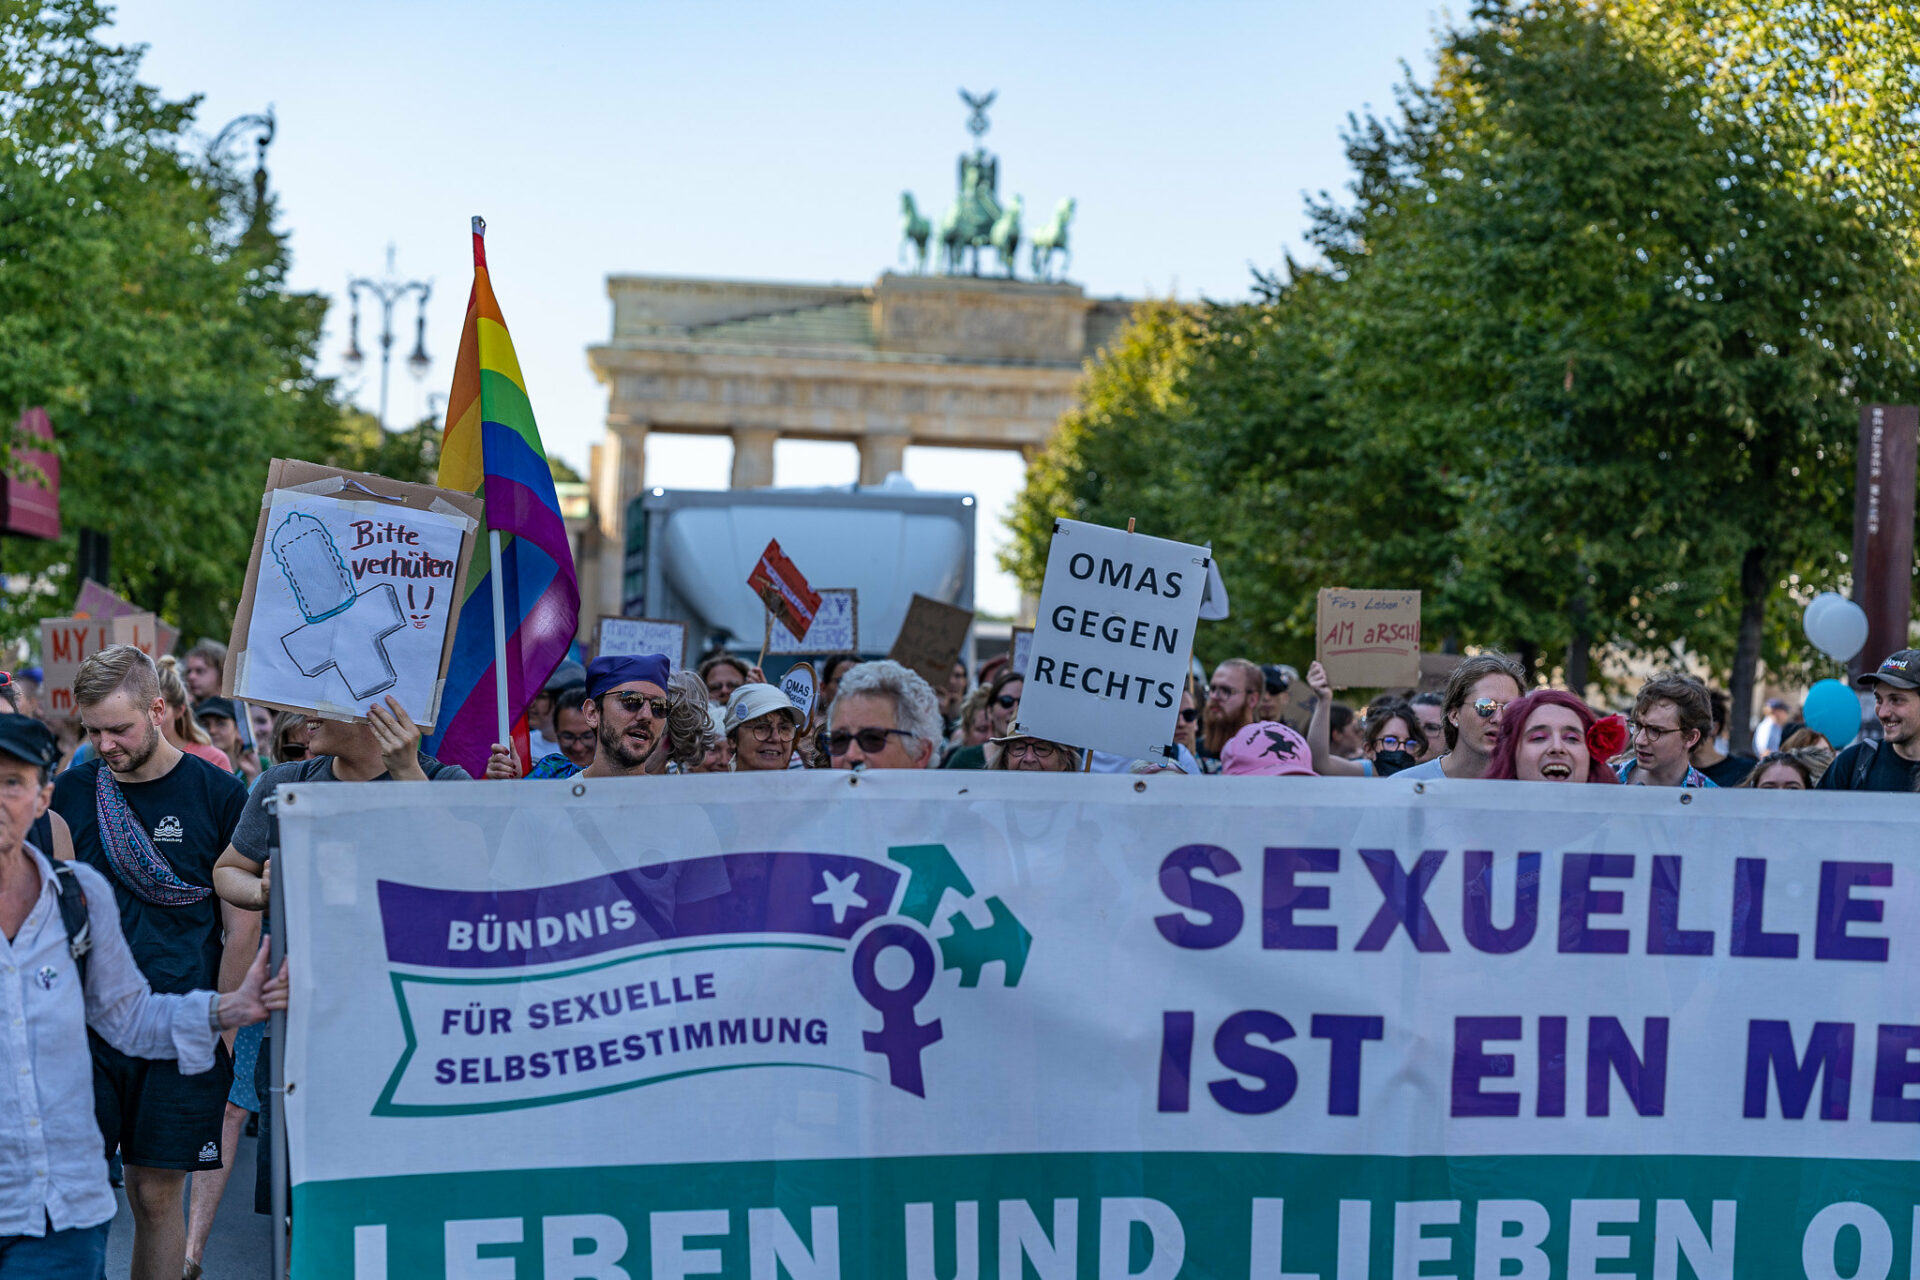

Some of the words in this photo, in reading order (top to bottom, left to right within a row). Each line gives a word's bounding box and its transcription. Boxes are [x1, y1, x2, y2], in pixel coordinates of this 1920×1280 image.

[349, 520, 420, 550] Bitte
[352, 549, 454, 580] verhüten
[1069, 552, 1183, 599] OMAS
[52, 626, 88, 662] MY
[1052, 605, 1179, 654] GEGEN
[1324, 620, 1354, 645] AM
[786, 679, 810, 697] OMAS
[1034, 656, 1175, 709] RECHTS
[447, 899, 636, 953] BÜNDNIS
[1153, 843, 1893, 962] SEXUELLE
[441, 1001, 512, 1035] FÜR
[527, 973, 717, 1030] SEXUELLE
[434, 1018, 829, 1085] SELBSTBESTIMMUNG
[1157, 1009, 1384, 1116] IST
[1450, 1015, 1669, 1118] EIN
[905, 1198, 1186, 1280] UND
[1249, 1197, 1737, 1280] LIEBEN
